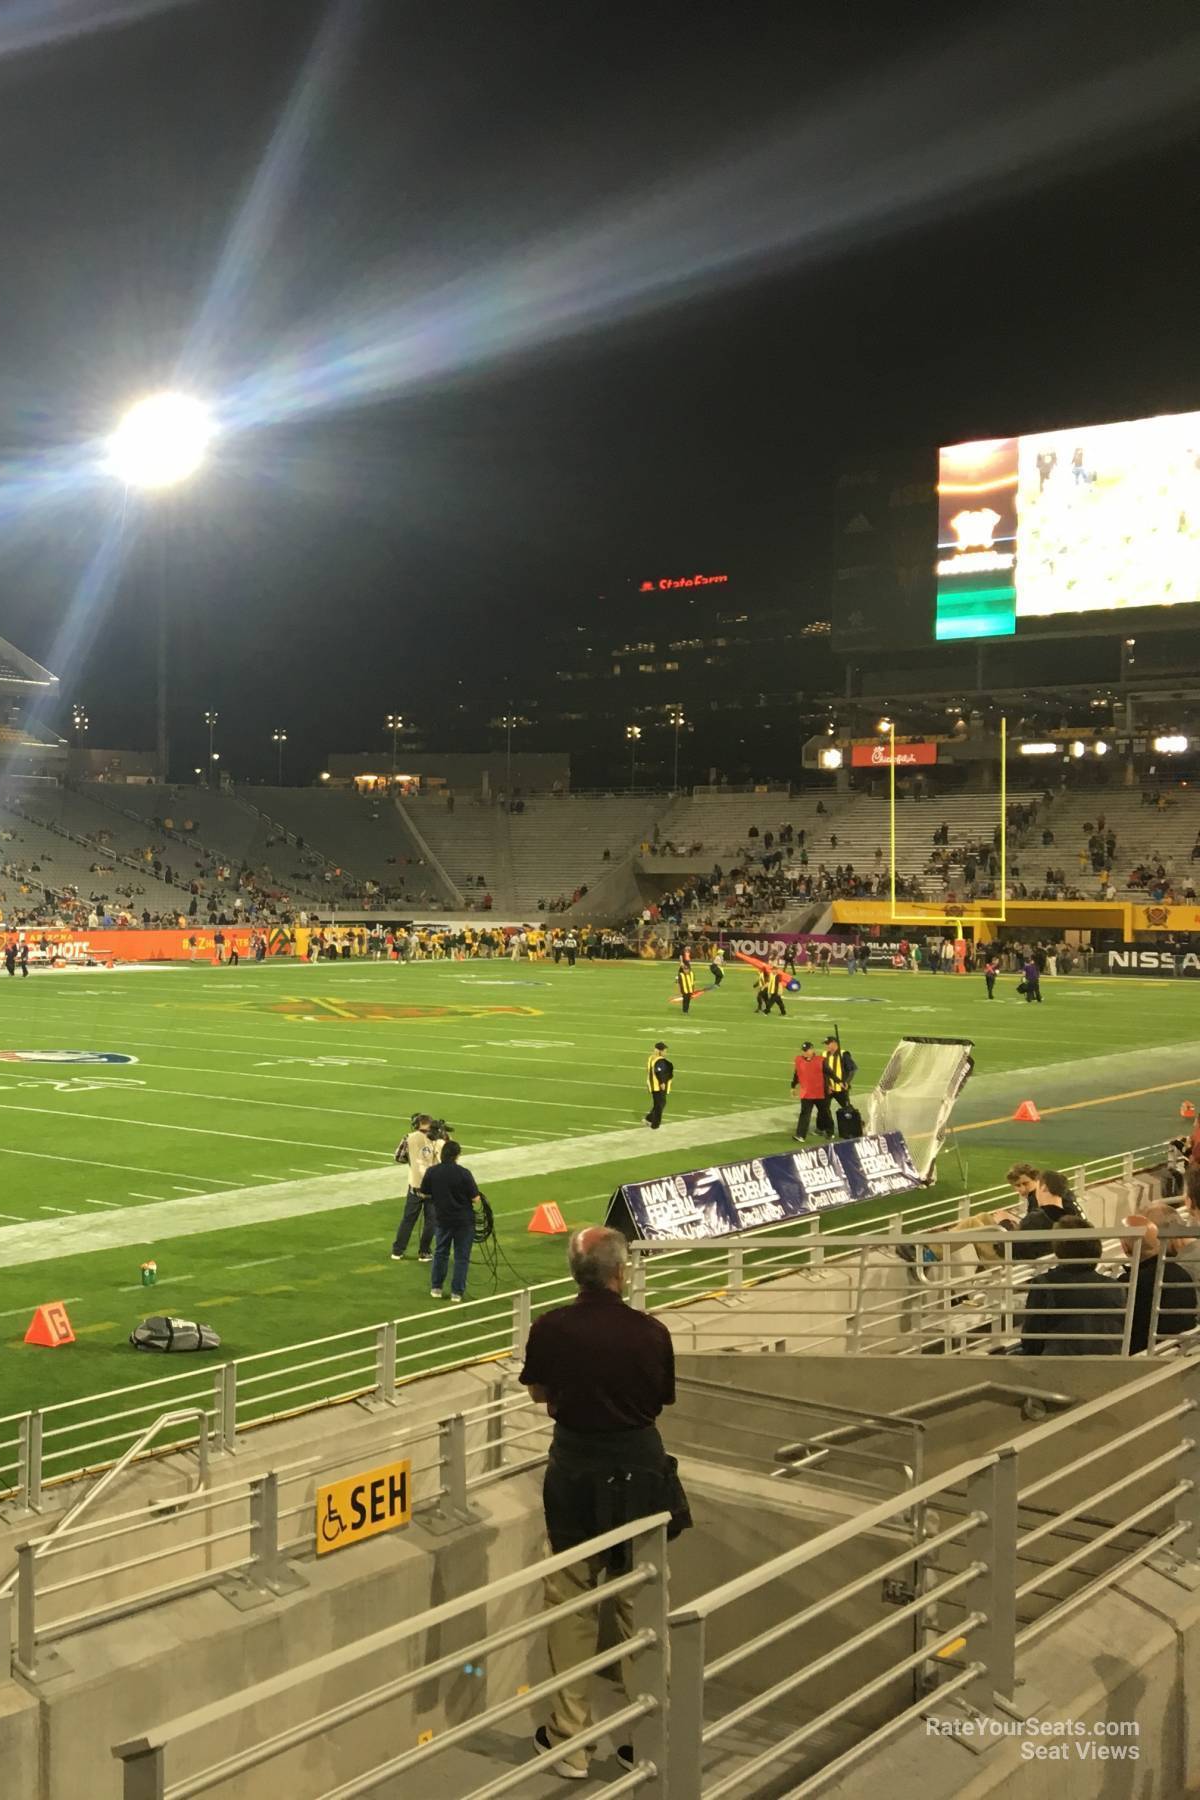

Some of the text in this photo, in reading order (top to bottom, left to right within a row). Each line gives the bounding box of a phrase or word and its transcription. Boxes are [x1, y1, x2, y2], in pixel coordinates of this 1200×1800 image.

[730, 940, 768, 957] YOU
[854, 1136, 881, 1159] NAVY
[793, 1149, 819, 1171] NAVY
[860, 1153, 899, 1175] FEDERAL
[721, 1163, 753, 1186] NAVY
[799, 1165, 841, 1188] FEDERAL
[640, 1180, 677, 1206] NAVY
[729, 1177, 777, 1204] FEDERAL
[645, 1196, 699, 1223] FEDERAL
[47, 1308, 71, 1341] G
[350, 1472, 407, 1531] SEH
